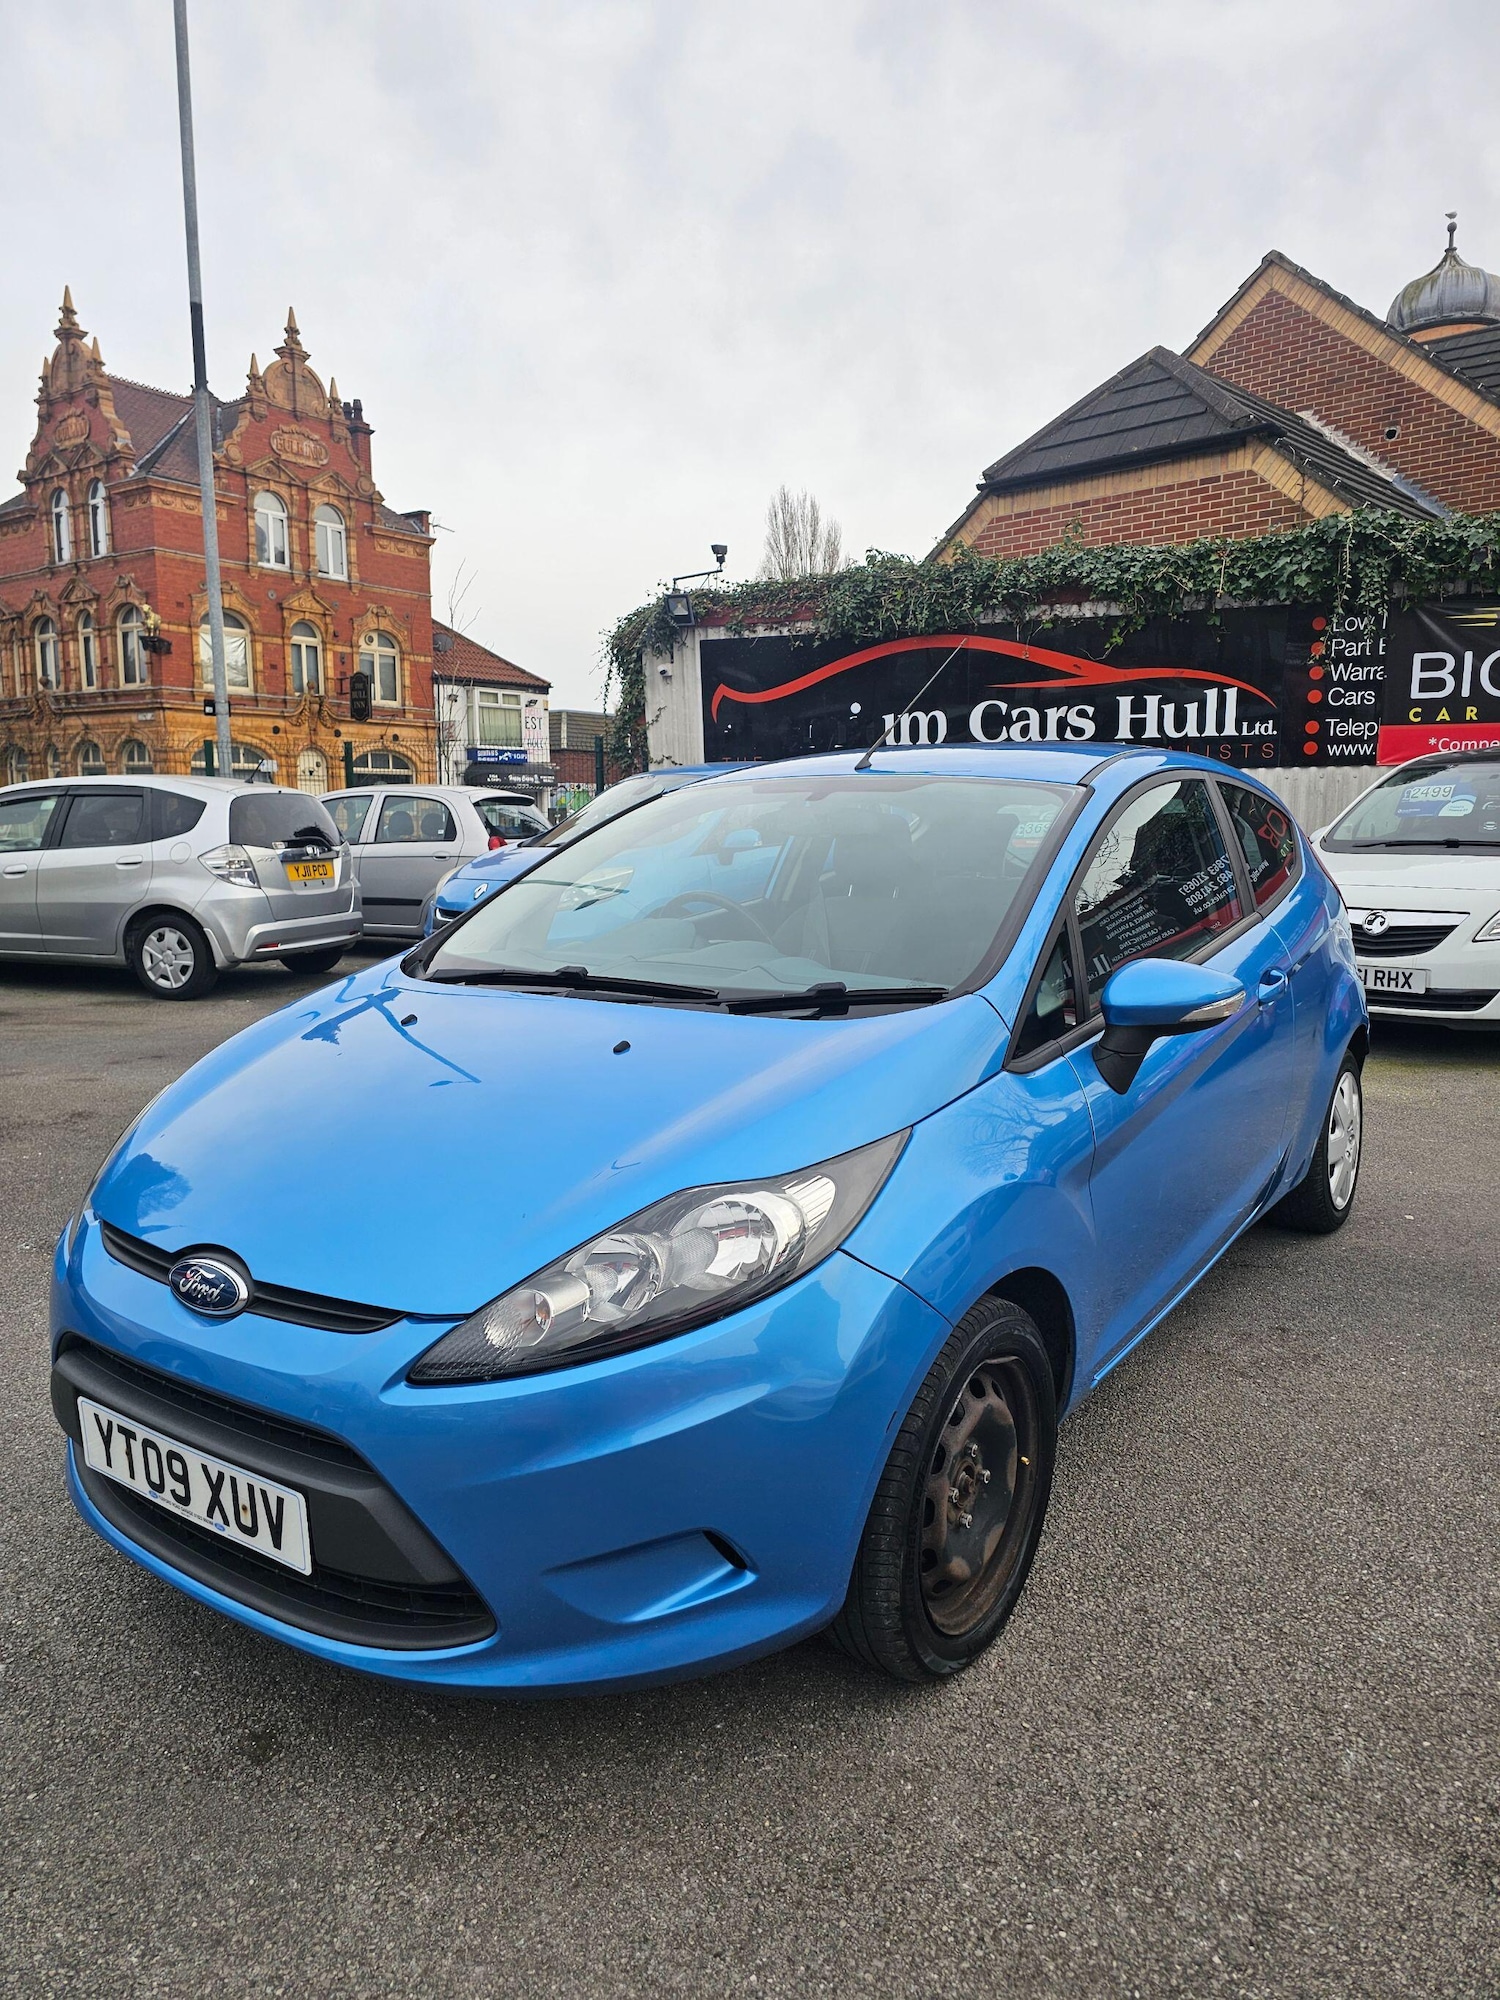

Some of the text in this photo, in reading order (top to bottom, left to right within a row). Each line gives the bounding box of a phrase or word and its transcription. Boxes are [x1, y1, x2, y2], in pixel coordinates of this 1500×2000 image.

[1331, 638, 1373, 657] Part
[352, 690, 367, 699] BULL
[1328, 687, 1375, 706] Cars
[354, 701, 366, 709] INN
[969, 700, 1096, 742] Cars
[1115, 686, 1242, 740] Hull
[1242, 719, 1278, 736] Ltd.
[1408, 706, 1478, 723] CAR
[1327, 743, 1376, 756] www.
[313, 864, 328, 877] PCD
[1374, 968, 1413, 990] RHX
[179, 1265, 225, 1302] Ford
[93, 1412, 285, 1551] YT09 XUV
